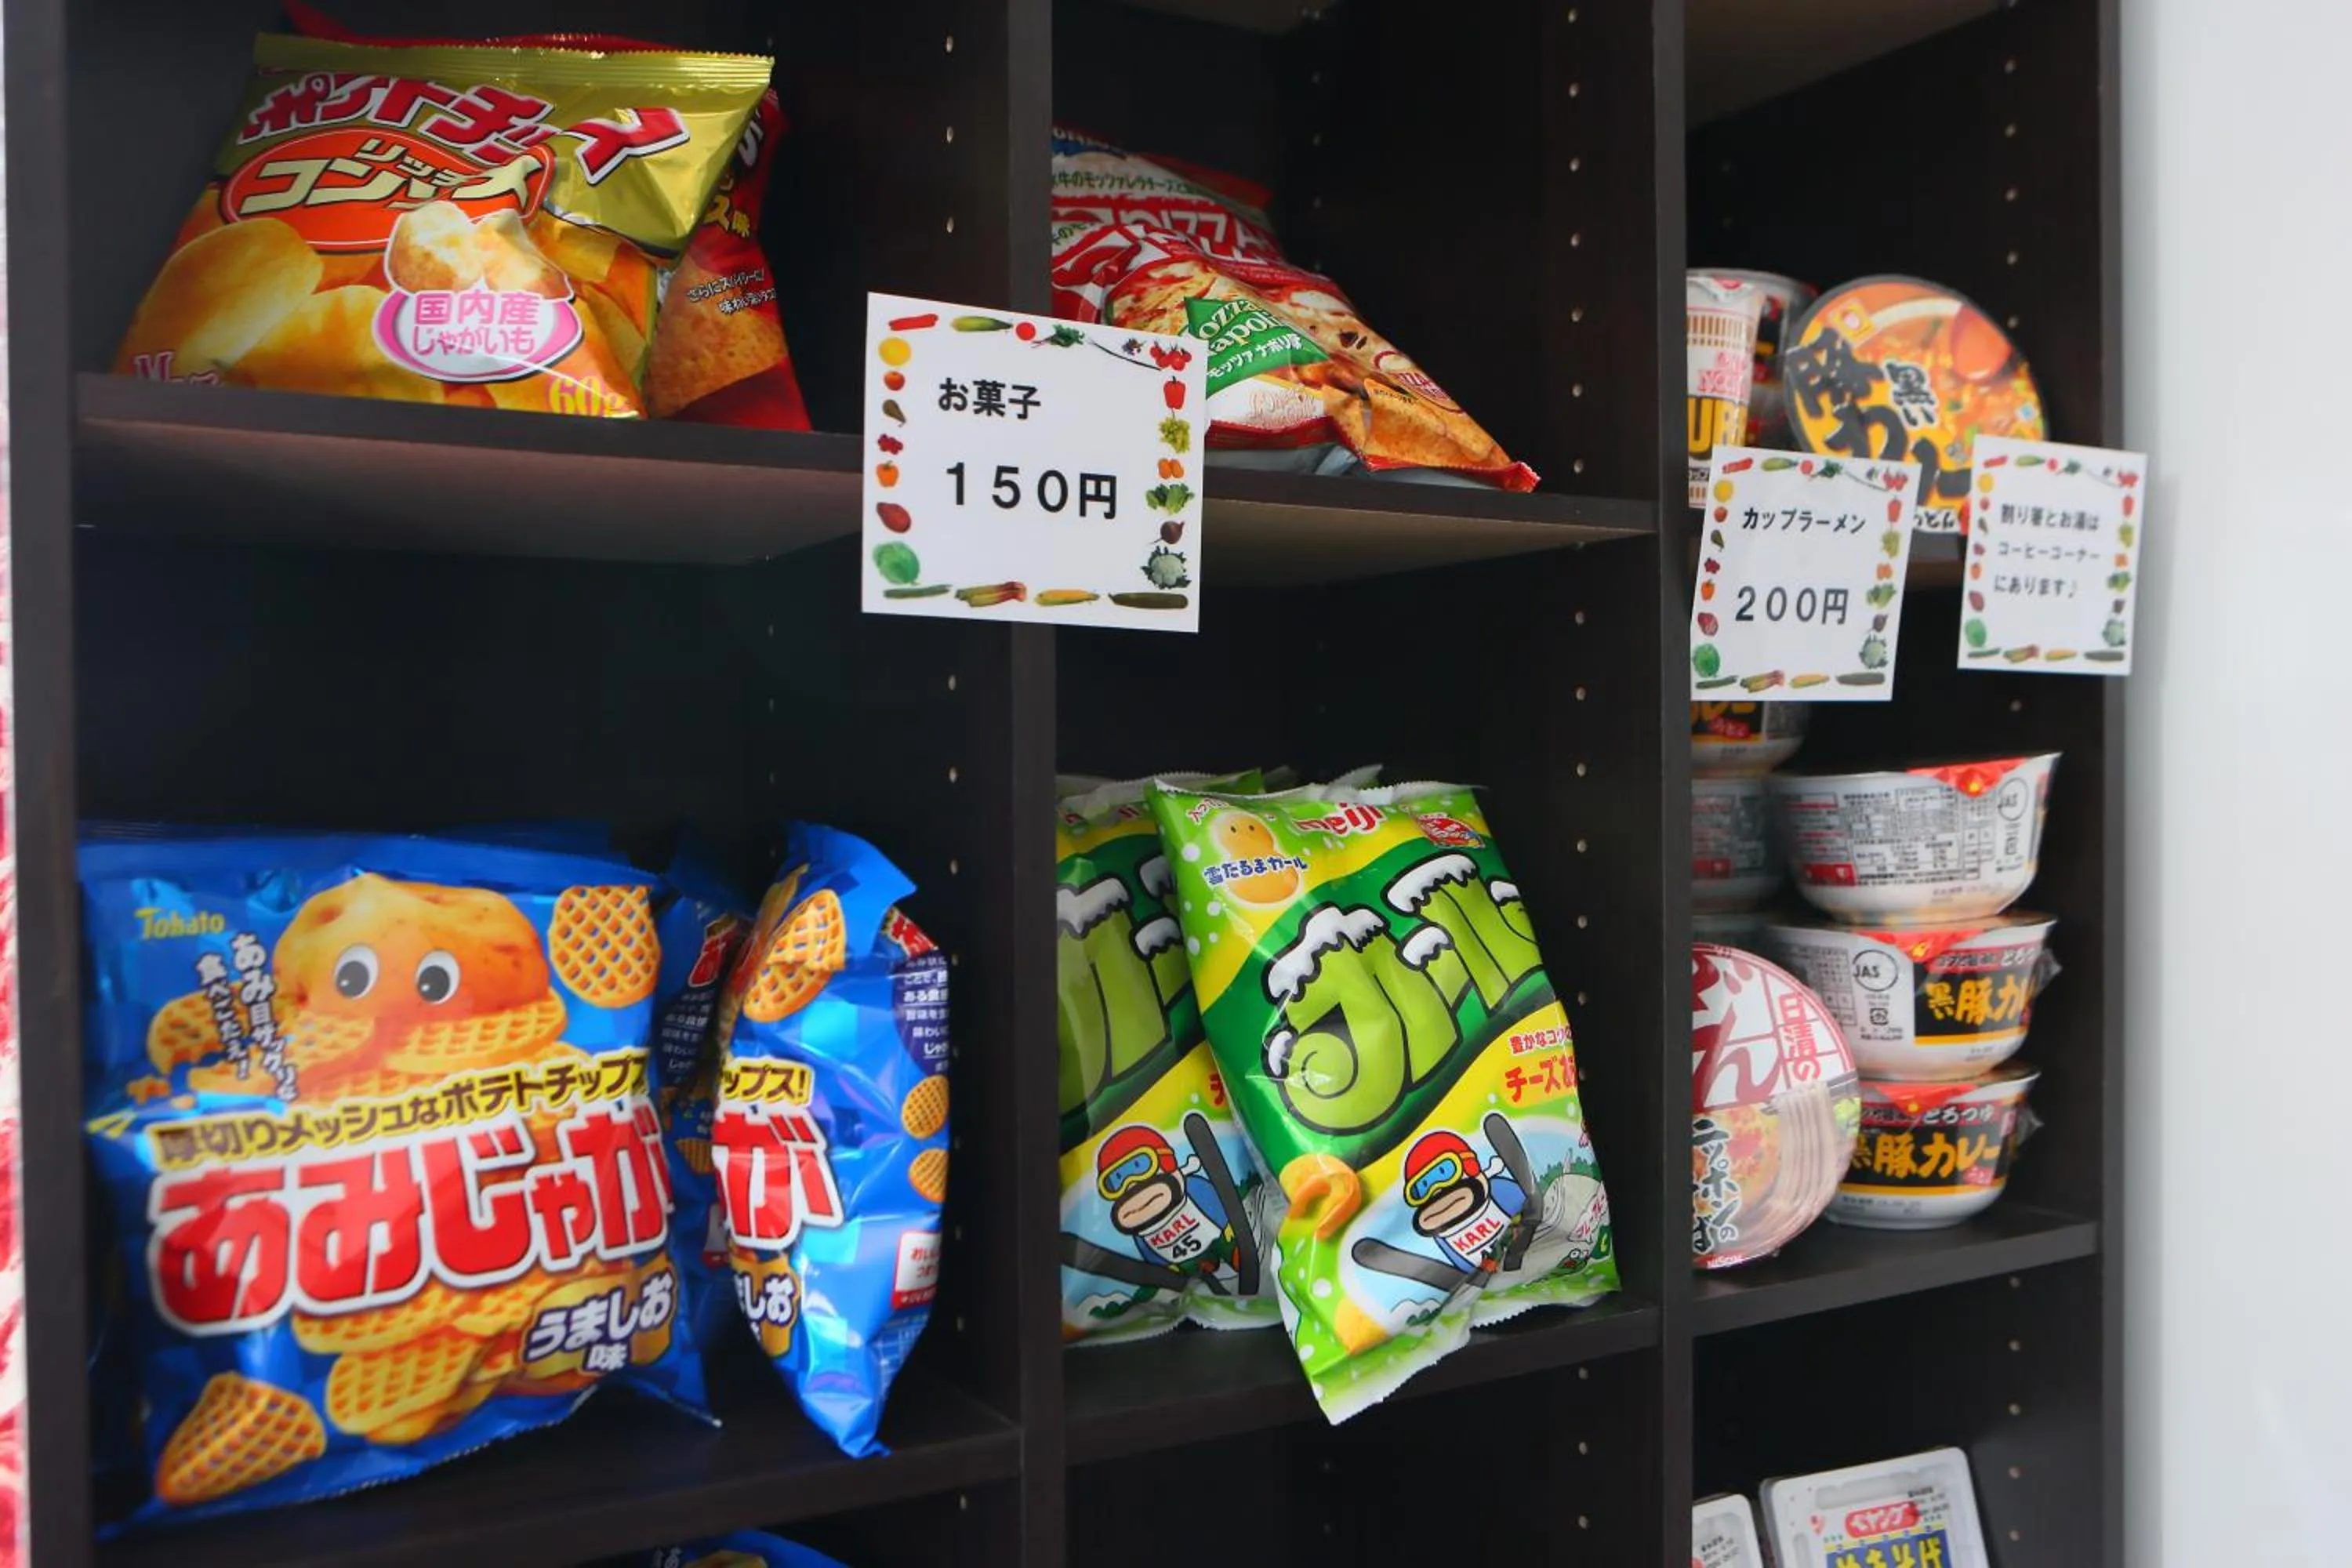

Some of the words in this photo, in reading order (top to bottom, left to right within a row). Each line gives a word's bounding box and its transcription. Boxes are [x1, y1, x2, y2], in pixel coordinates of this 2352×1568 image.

[415, 292, 540, 325] 国内産
[412, 326, 535, 357] じゃがいも
[938, 378, 1041, 420] お菓子
[946, 461, 1118, 520] 150円
[1741, 506, 1867, 535] カップラーメン
[2001, 503, 2099, 531] 割り箸とお湯は
[1998, 541, 2100, 562] コーヒーコーナー
[1735, 584, 1849, 626] 200円
[1294, 802, 1386, 835] meiji
[135, 907, 225, 938] Tohato
[1853, 964, 1881, 979] JAS
[1778, 991, 1821, 1082] 日清の
[157, 1105, 671, 1322] あみじゃが
[1148, 1213, 1197, 1247] KARL
[1171, 1235, 1202, 1261] 45
[1454, 1216, 1502, 1253] KARL
[528, 1272, 673, 1360] うましお
[587, 1344, 628, 1371] 味
